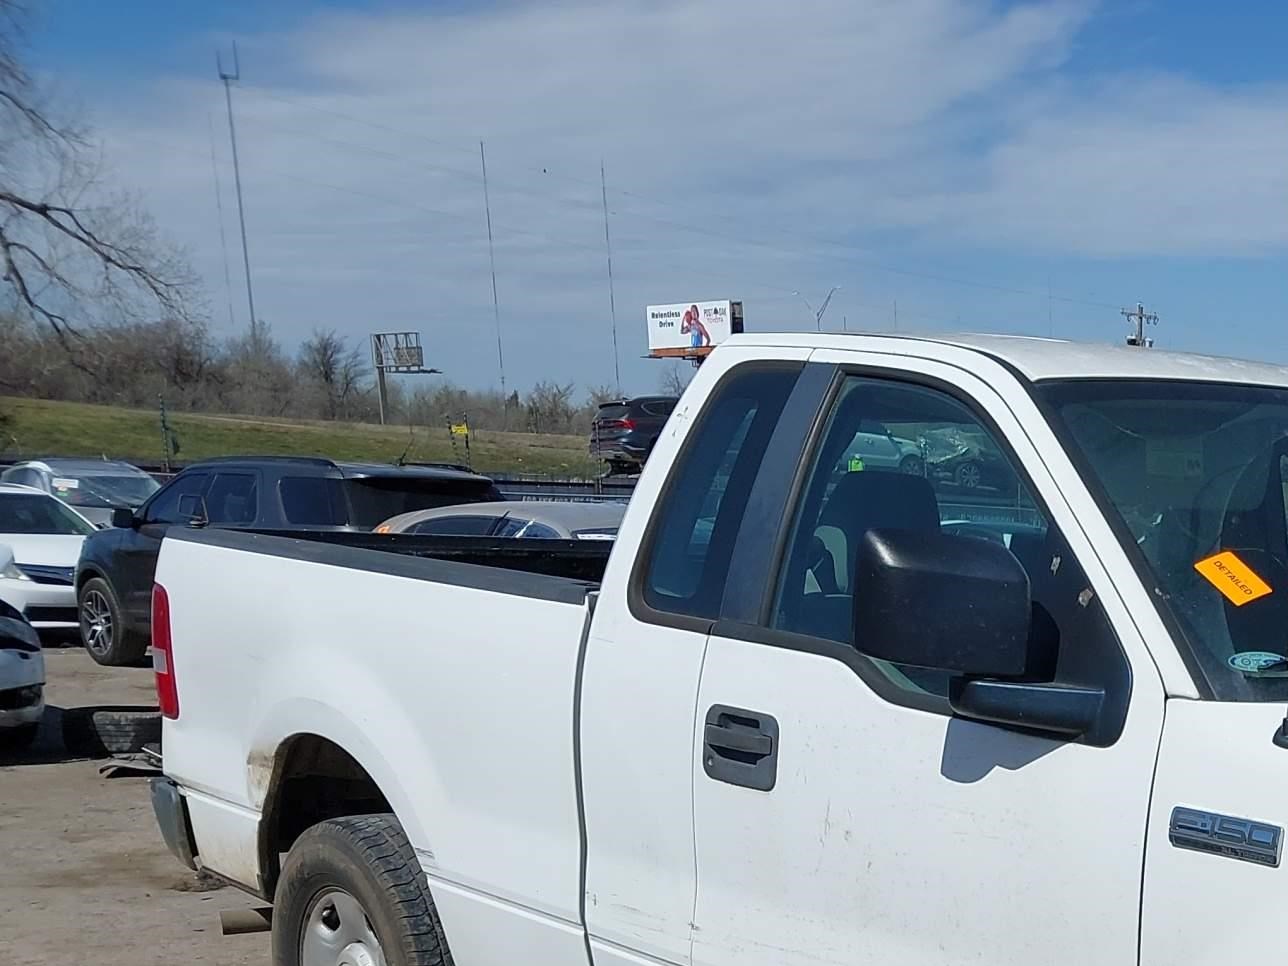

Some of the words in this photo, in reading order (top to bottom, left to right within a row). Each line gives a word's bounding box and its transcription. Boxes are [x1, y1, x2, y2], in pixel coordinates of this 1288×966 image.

[651, 310, 681, 320] Relentless
[658, 320, 674, 328] Drive
[1213, 560, 1253, 596] DETAILED
